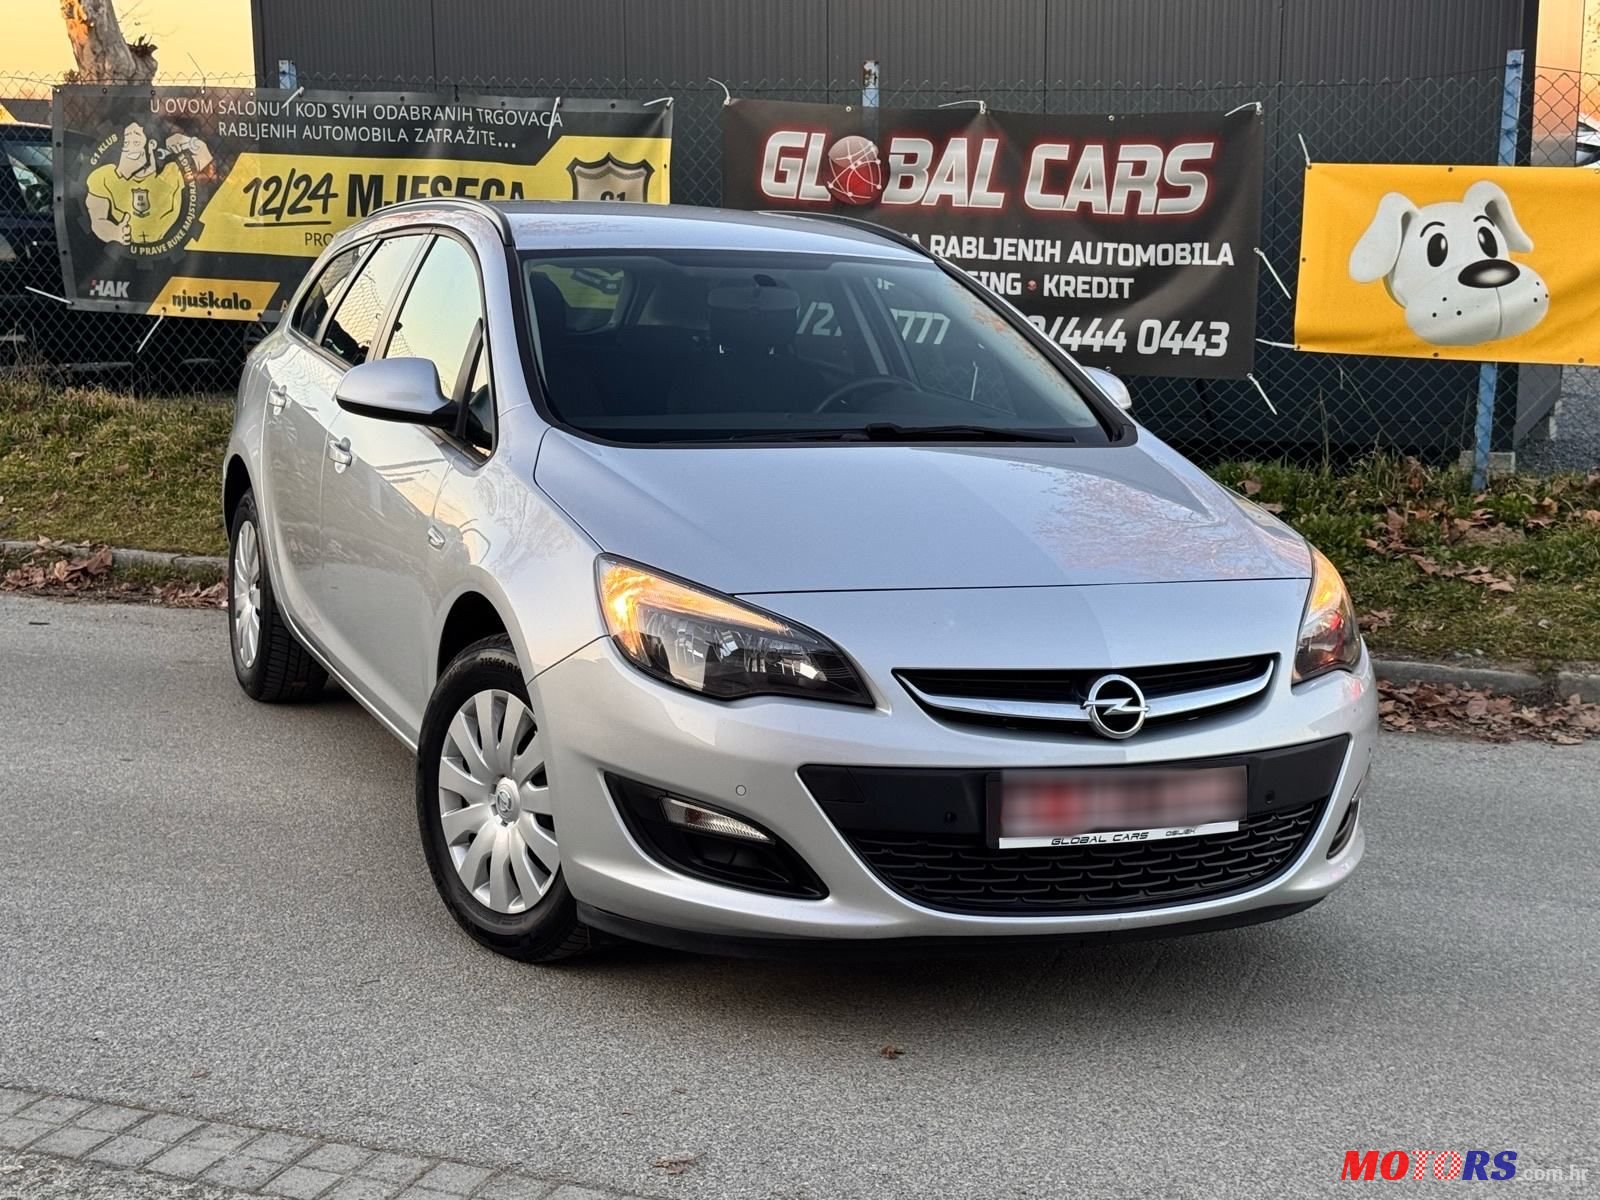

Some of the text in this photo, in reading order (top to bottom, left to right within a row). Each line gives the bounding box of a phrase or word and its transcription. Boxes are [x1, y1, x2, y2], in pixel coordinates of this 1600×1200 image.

[150, 98, 563, 128] U OVOM SALONU I KOD SVIH ODABRANIH TRGOVACA
[90, 133, 118, 166] G1 KLUB
[218, 122, 516, 149] RABLJENIH AUTOMOBILA ZATRAŽITE...
[760, 130, 1215, 216] GLOBAL CARS
[243, 168, 339, 222] 12/24
[130, 245, 137, 254] U
[139, 243, 168, 256] PRAVE
[166, 229, 186, 249] RUKE
[182, 180, 197, 232] MAJSTORA
[930, 234, 1062, 263] RABLJENIH
[1067, 240, 1235, 267] AUTOMOBILA
[89, 279, 130, 298] HAK
[966, 270, 1135, 299] ING KREDIT
[171, 289, 252, 313] njuškalo
[1136, 319, 1231, 357] 0443
[1050, 835, 1107, 846] GLOBAL
[1112, 831, 1150, 842] CARS
